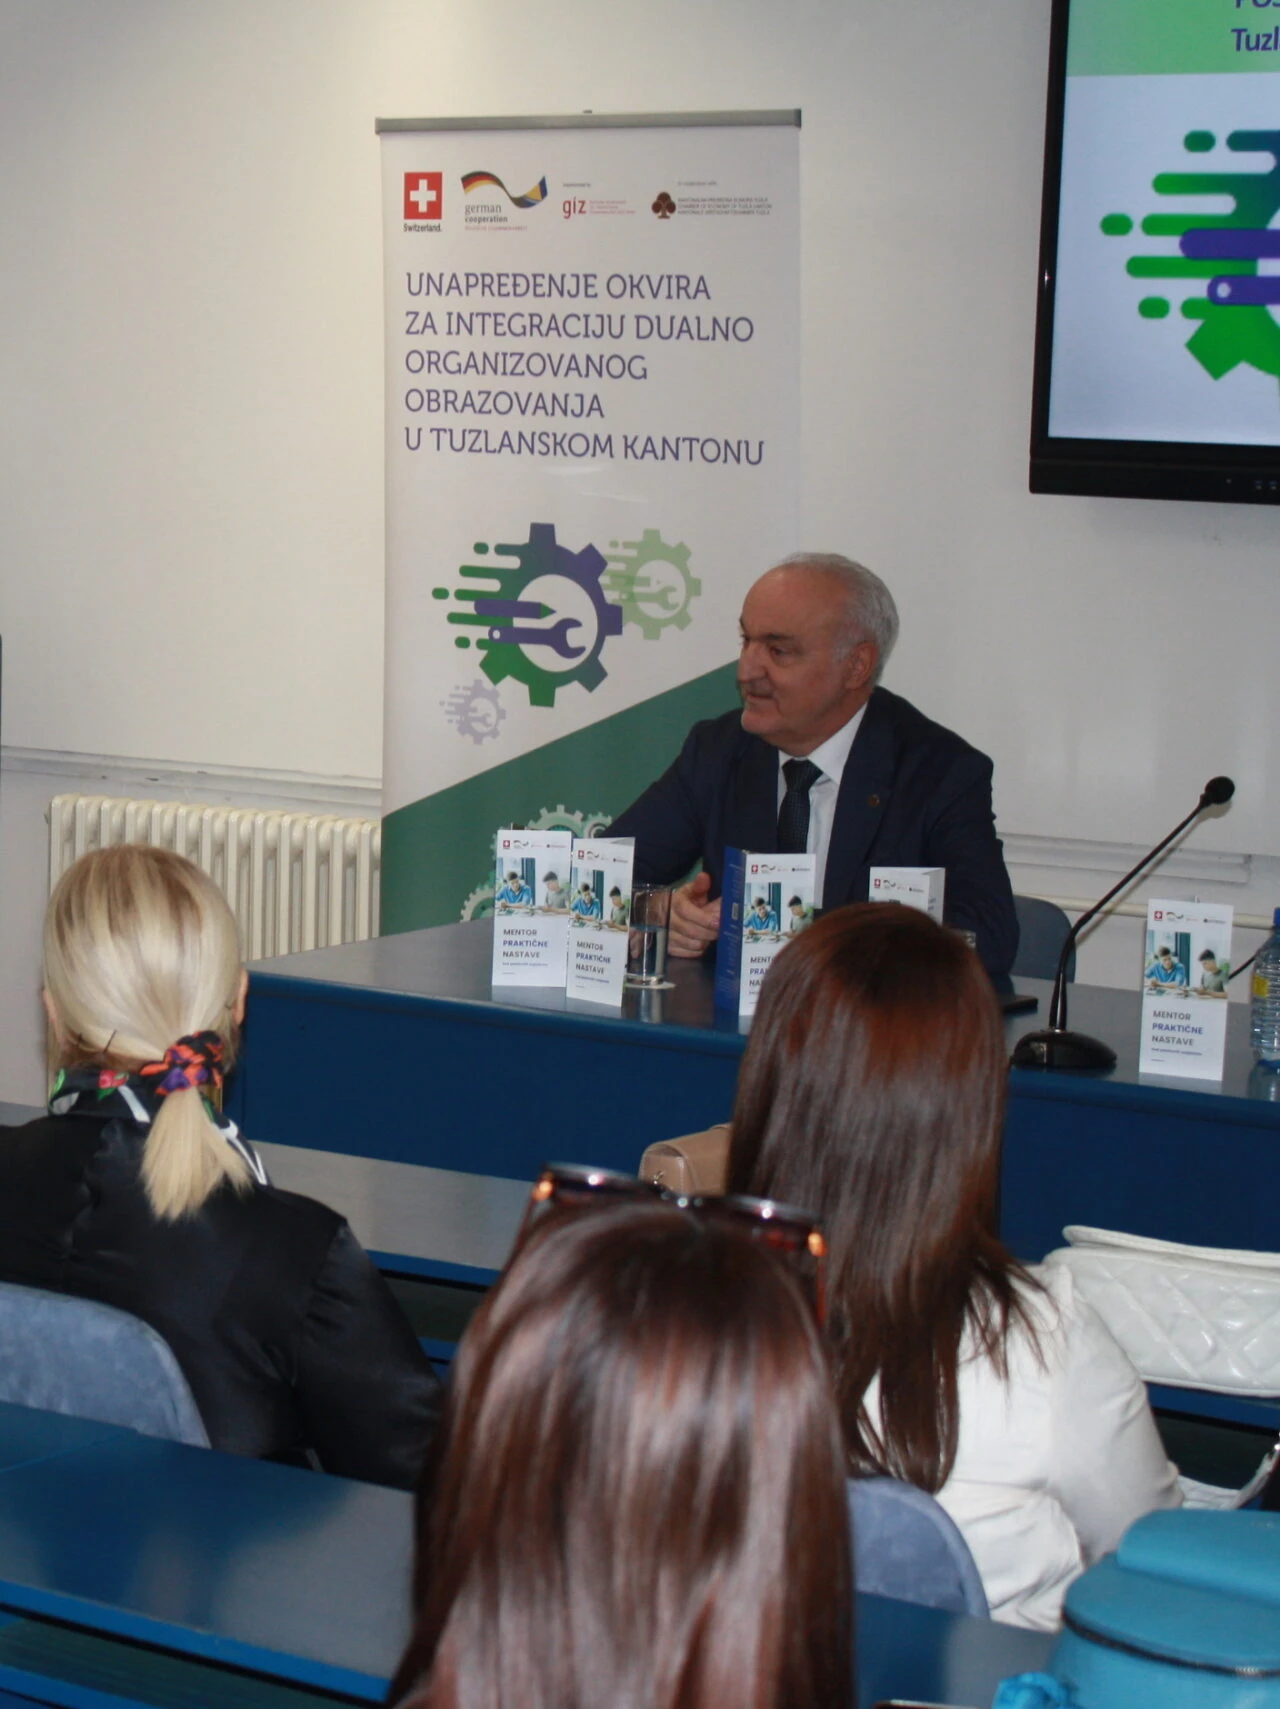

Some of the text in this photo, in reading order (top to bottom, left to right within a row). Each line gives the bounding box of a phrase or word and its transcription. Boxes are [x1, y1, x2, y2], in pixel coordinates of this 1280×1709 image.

[464, 204, 502, 214] german
[563, 196, 587, 219] giz
[464, 215, 508, 223] cooperation
[406, 272, 711, 300] UNAPREĐENJE OKVIRA
[405, 311, 754, 342] ZA INTEGRACIJU DUALNO
[405, 350, 647, 380] ORGANIZOVANOG
[405, 388, 605, 418] OBRAZOVANJA
[405, 427, 764, 466] U TUZLANSKOM KANTONU
[503, 939, 548, 948] PRAKTIČNE
[576, 941, 604, 951] MENTOR
[576, 952, 611, 964] PRAKTIČNE
[576, 963, 605, 974] NASTAVE
[750, 967, 768, 975] PRA
[1152, 1010, 1191, 1021] MENTOR
[1152, 1022, 1203, 1035] PRAKTIČNE
[1151, 1035, 1194, 1046] NASTAVE
